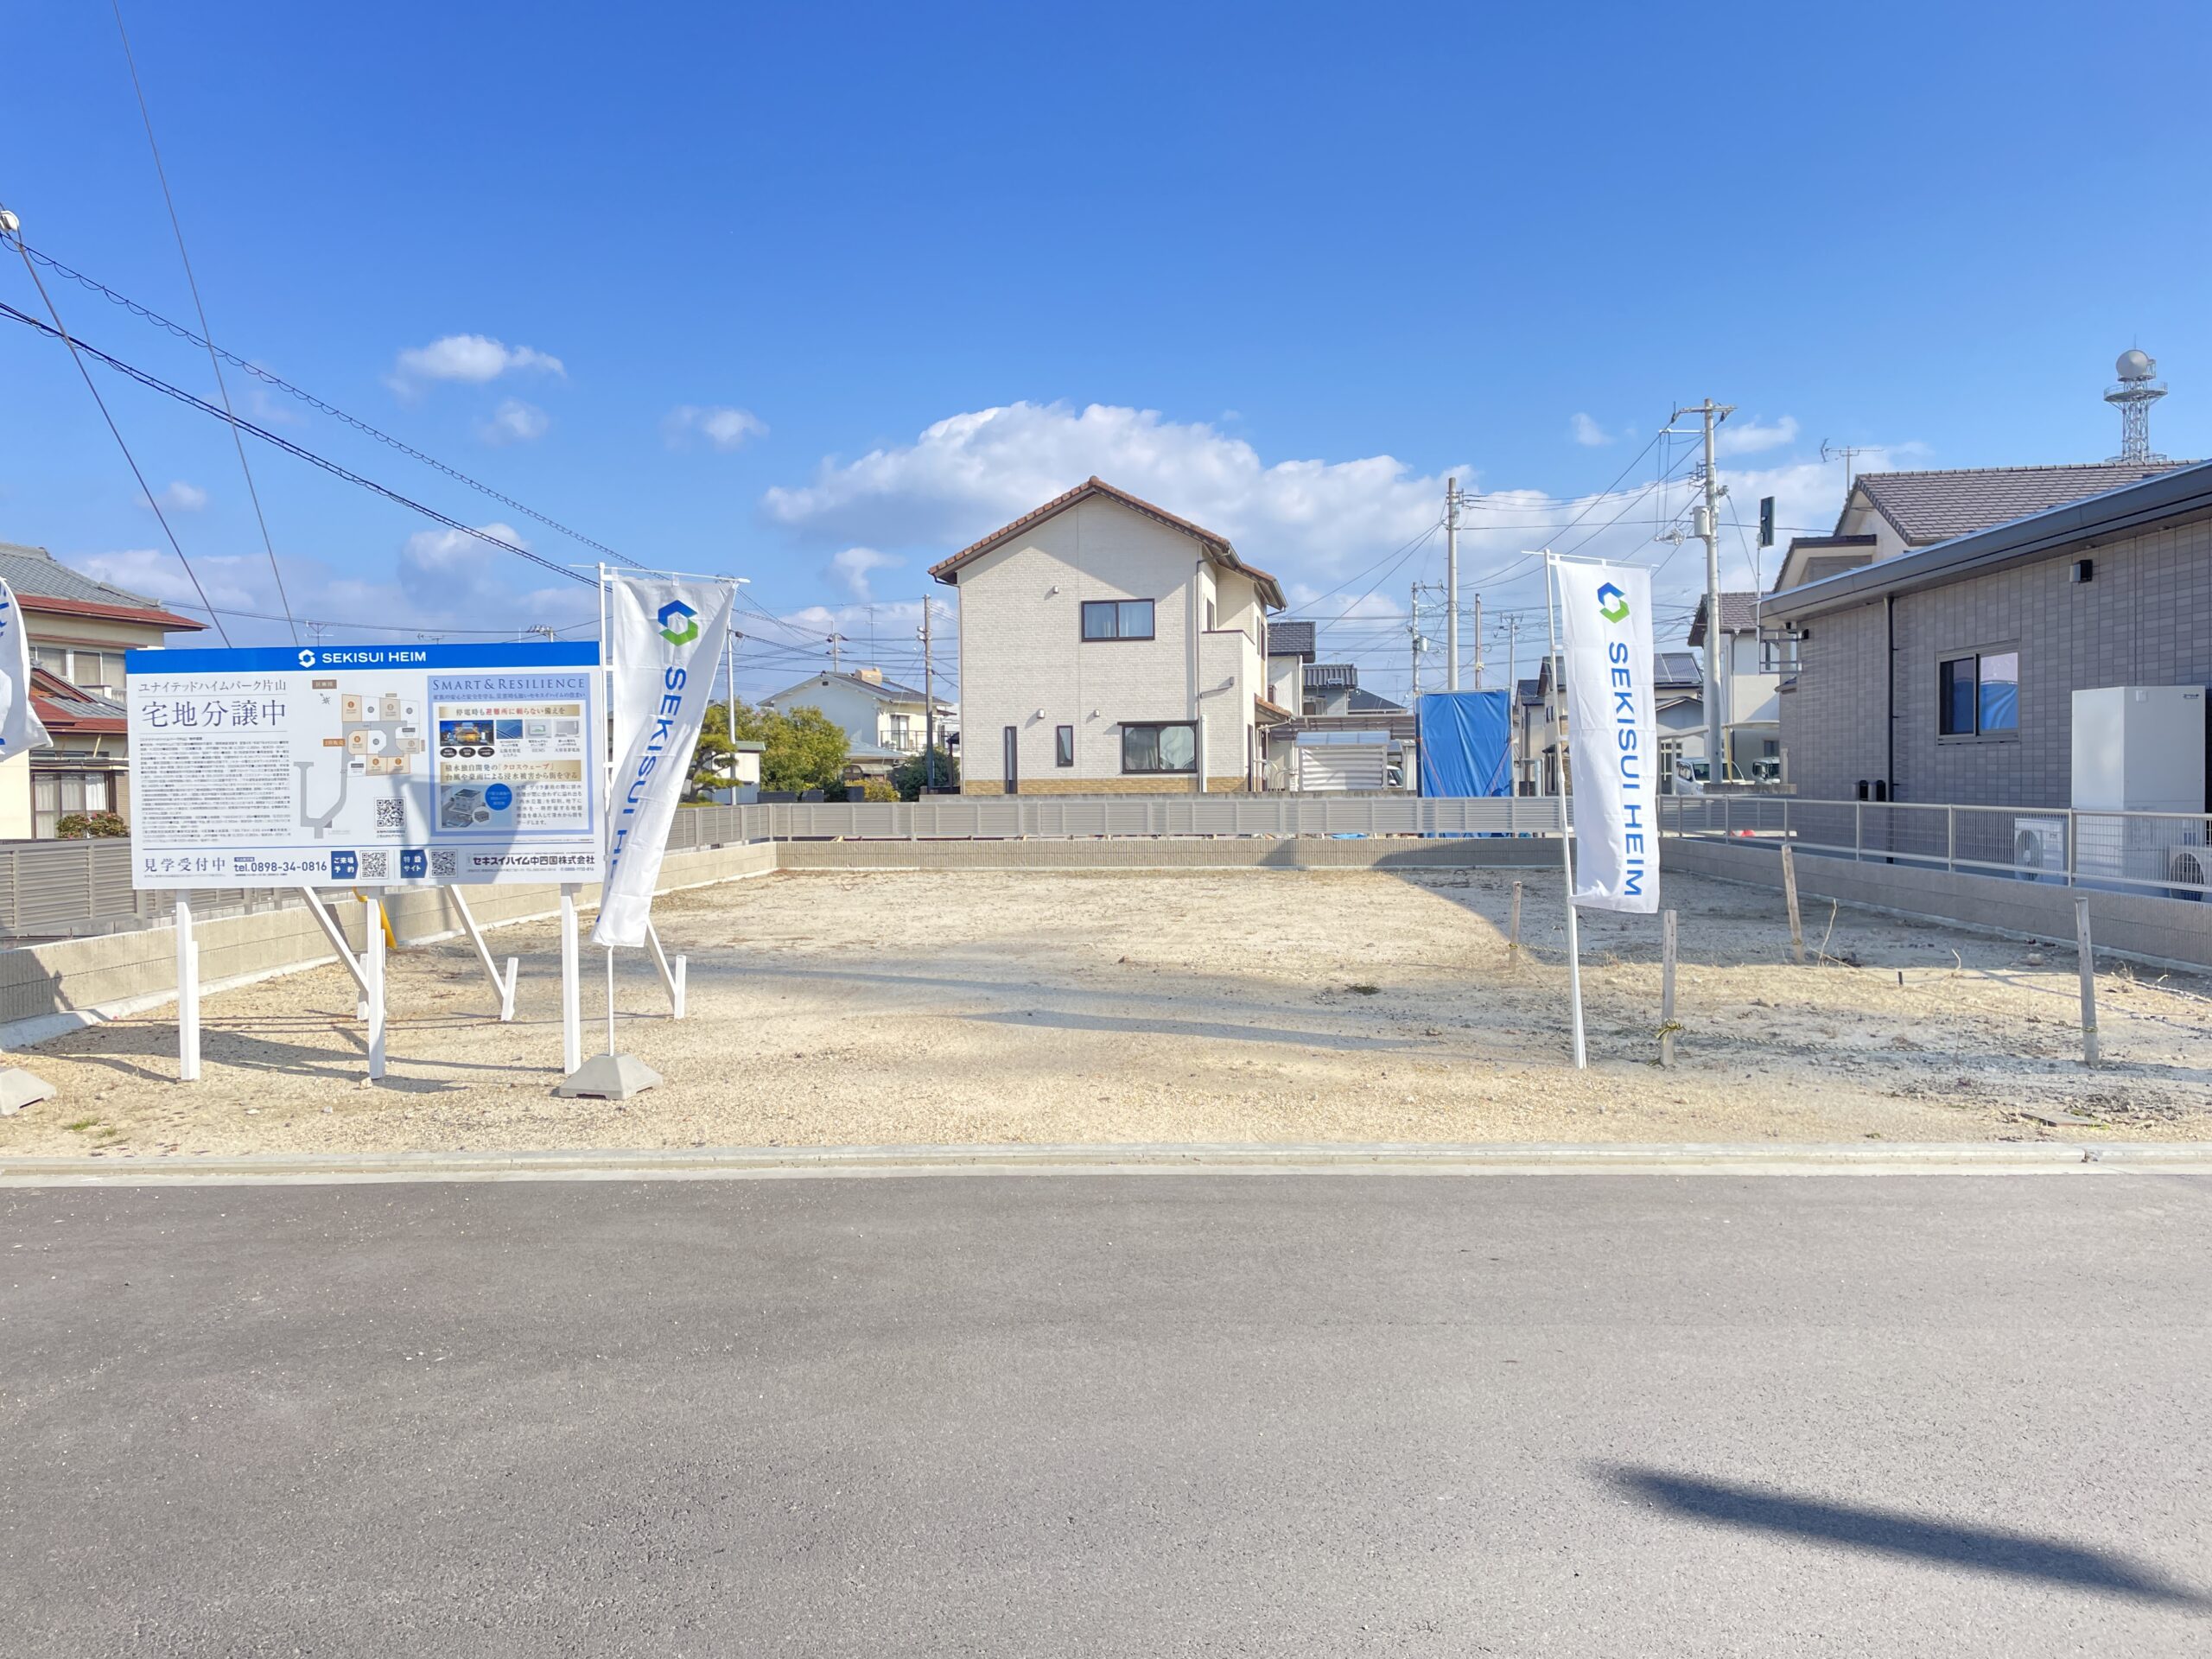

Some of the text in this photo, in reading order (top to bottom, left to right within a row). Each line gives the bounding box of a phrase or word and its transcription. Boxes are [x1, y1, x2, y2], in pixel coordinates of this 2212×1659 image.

[322, 652, 427, 663] SEKISUI HEIM
[138, 679, 286, 693] ユナイテッドハイムパーク片山
[142, 699, 286, 728] 宅地分譲中
[622, 666, 687, 814] SEKISUI
[1609, 641, 1644, 896] SEKISUI HEIM
[144, 857, 226, 873] 見学受付中
[473, 855, 595, 866] セキスイハイム中四国株式会社
